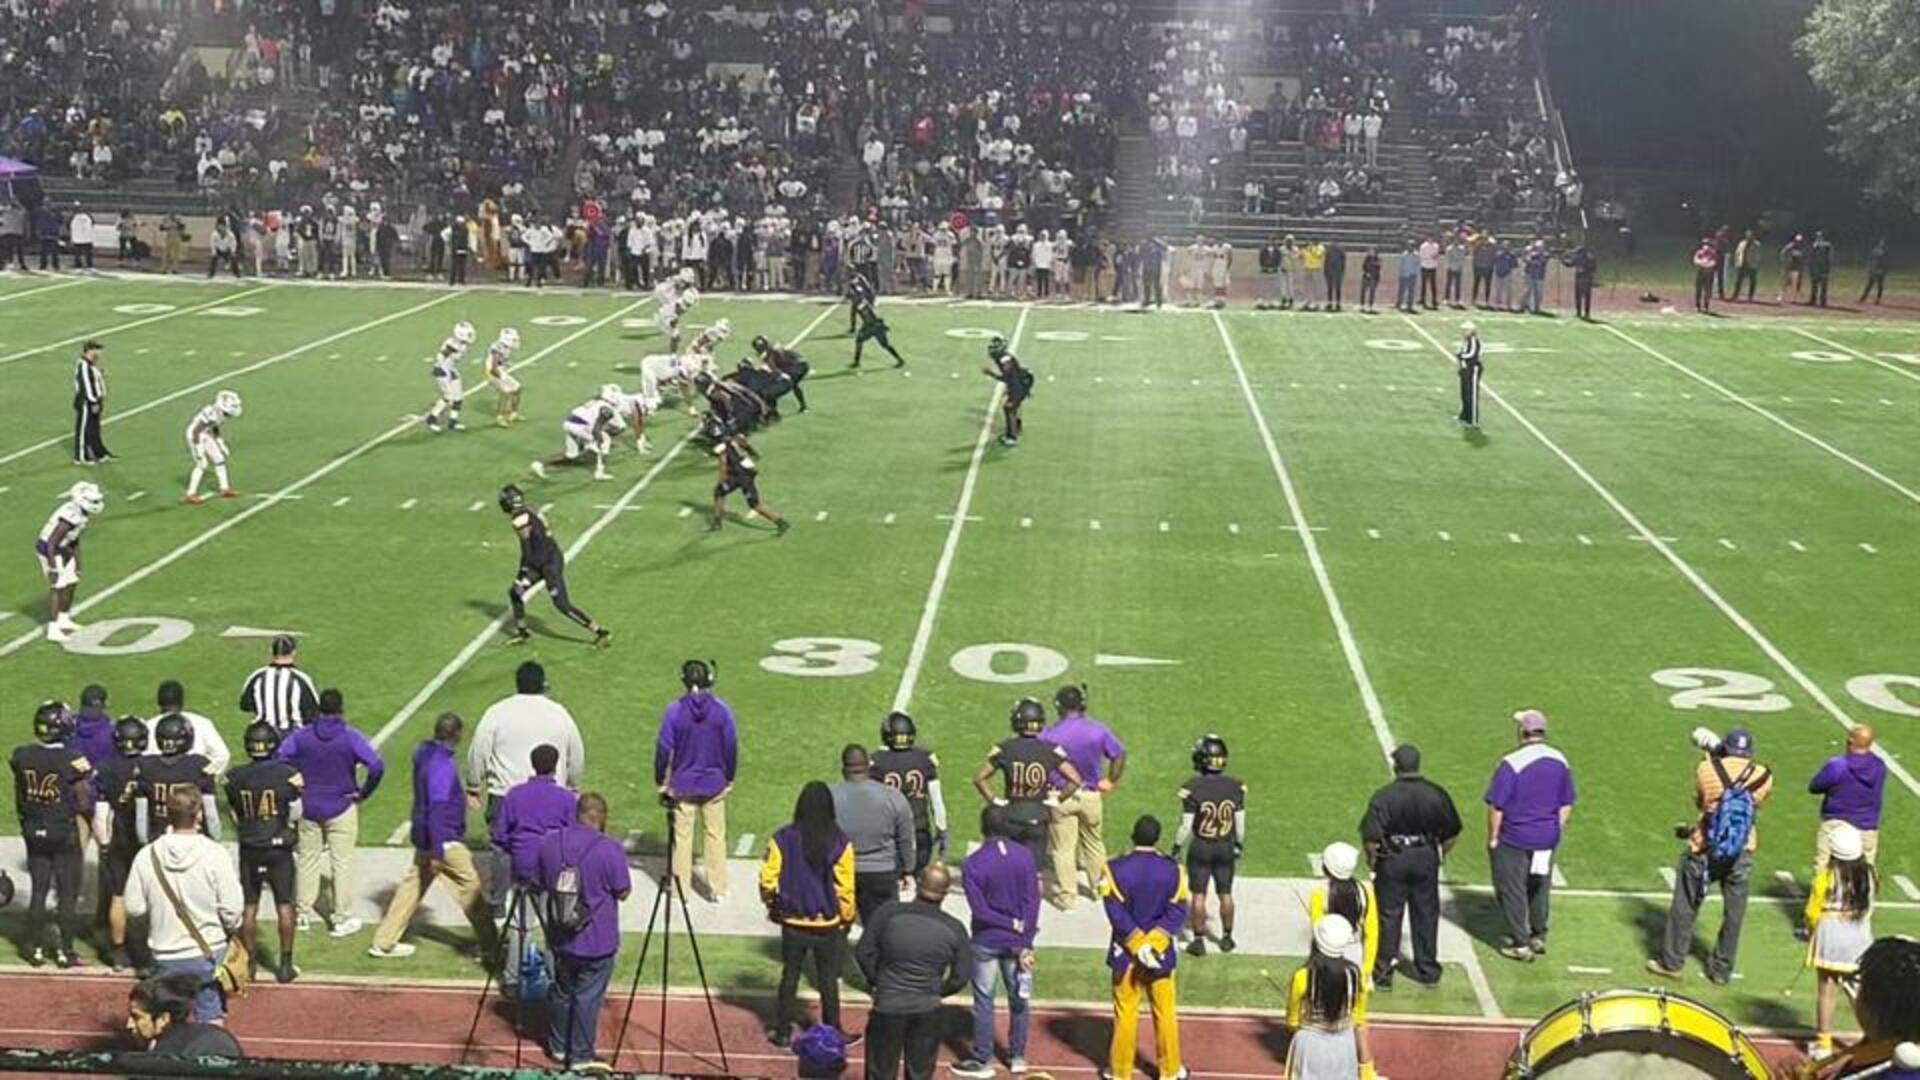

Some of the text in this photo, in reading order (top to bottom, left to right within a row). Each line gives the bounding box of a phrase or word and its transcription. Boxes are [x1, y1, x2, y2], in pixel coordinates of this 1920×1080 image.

[1012, 762, 1046, 797] 19
[240, 789, 278, 821] 14
[1198, 799, 1236, 839] 29
